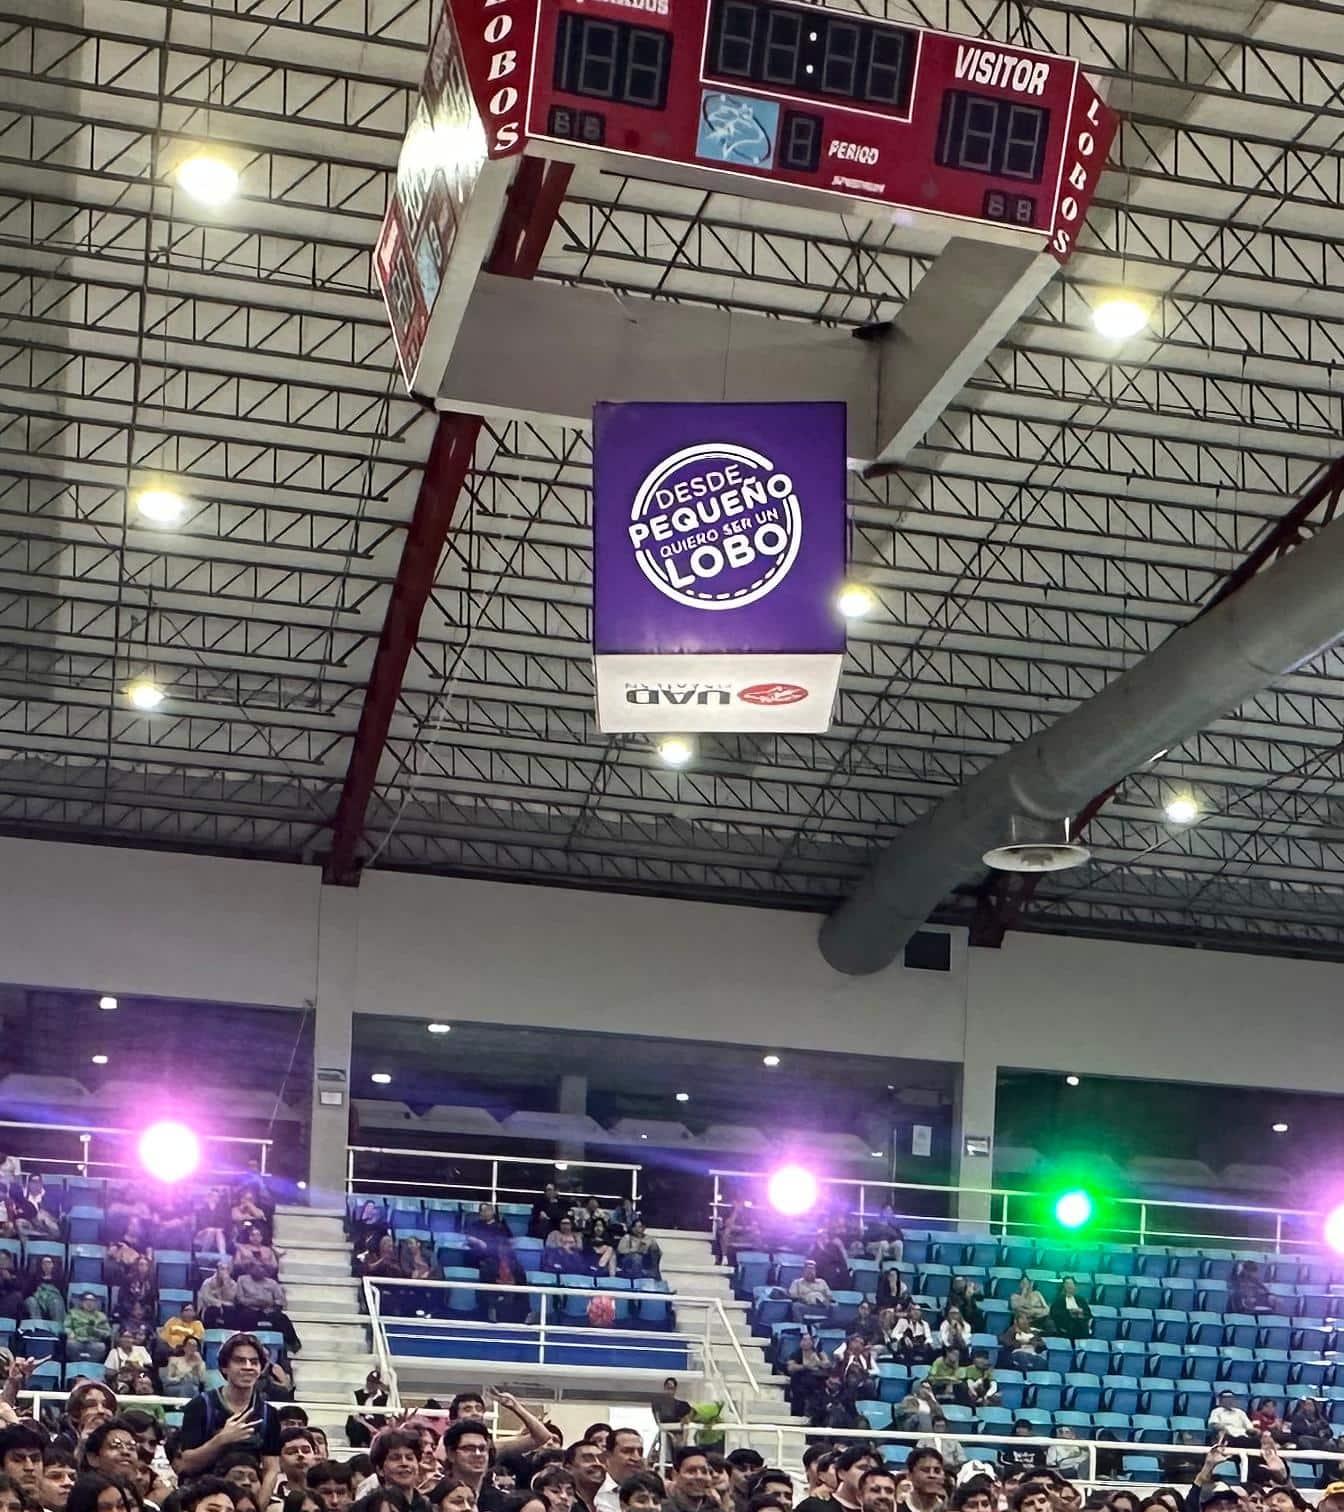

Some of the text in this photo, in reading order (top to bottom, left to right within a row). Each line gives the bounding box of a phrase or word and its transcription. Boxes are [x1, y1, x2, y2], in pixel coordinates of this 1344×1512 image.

[484, 0, 519, 151] OBOS
[954, 45, 1050, 96] VISITOR
[1053, 98, 1099, 254] LOBOS
[628, 473, 793, 549] PEQUEÑO
[655, 464, 743, 510] DESDE
[660, 508, 779, 558] QUIERO SER UN
[664, 522, 788, 589] LOBO
[625, 689, 732, 705] UAD
